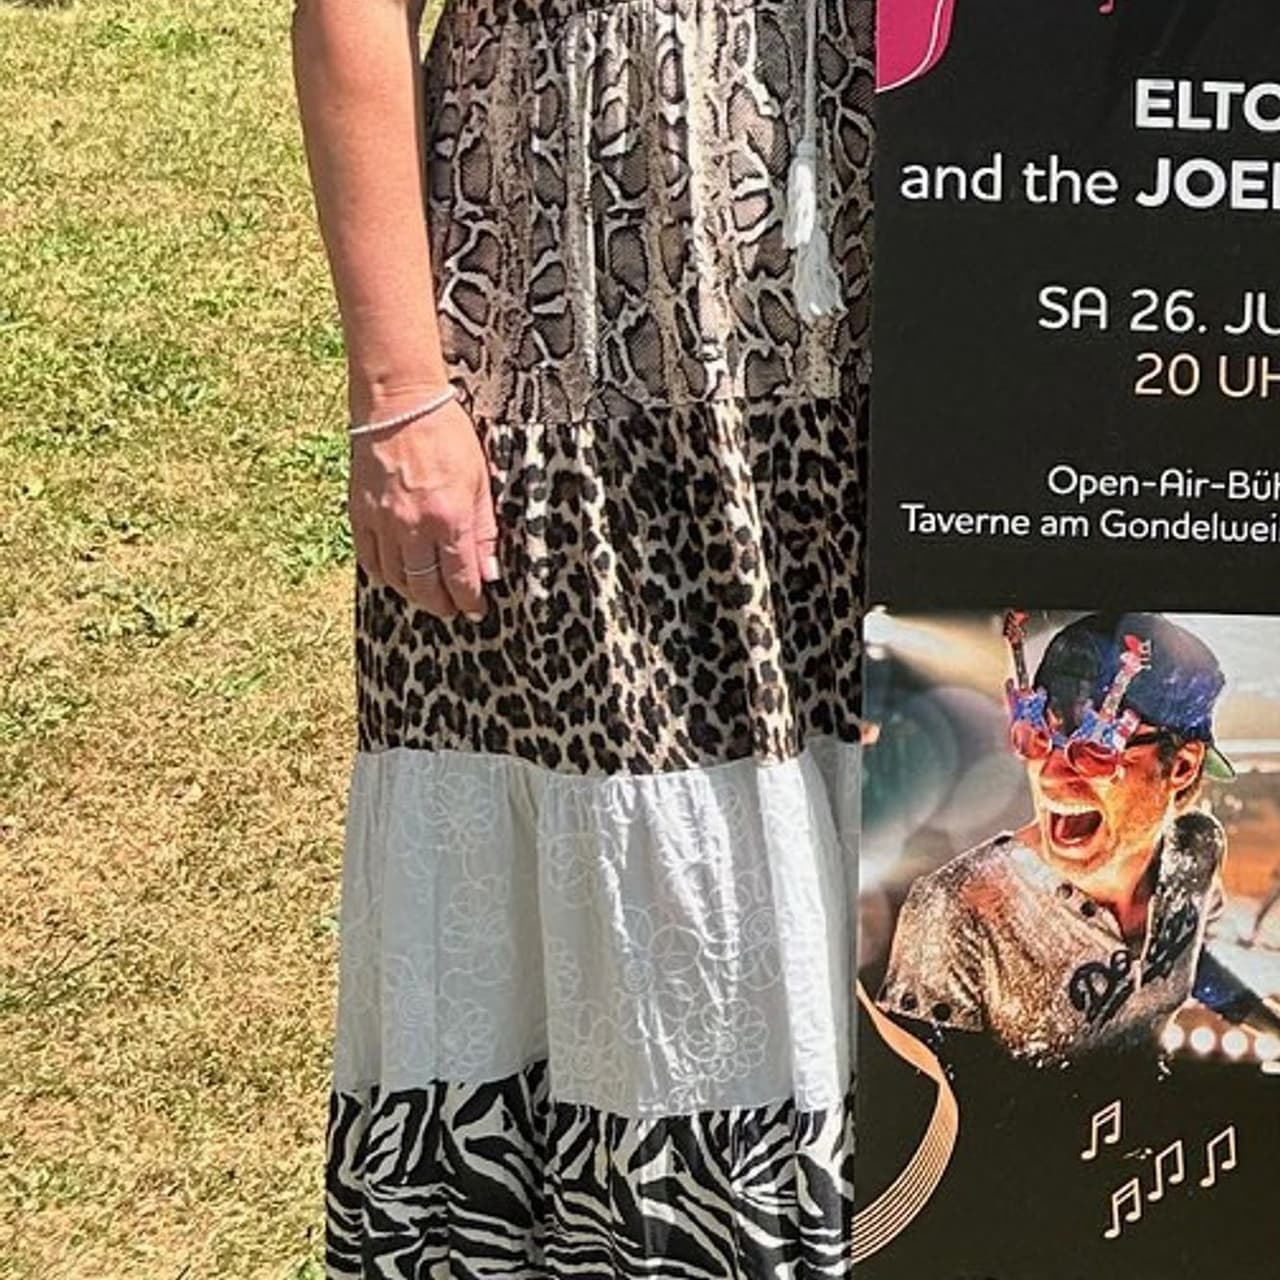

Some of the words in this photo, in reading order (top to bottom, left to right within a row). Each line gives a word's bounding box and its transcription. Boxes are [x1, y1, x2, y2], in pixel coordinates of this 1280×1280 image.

[900, 153, 1003, 202] and
[1023, 155, 1119, 205] the
[1038, 286, 1108, 330] SA
[1129, 288, 1206, 334] 26.
[1134, 352, 1200, 396] 20
[901, 502, 1030, 536] Taverne
[1041, 512, 1089, 537] am
